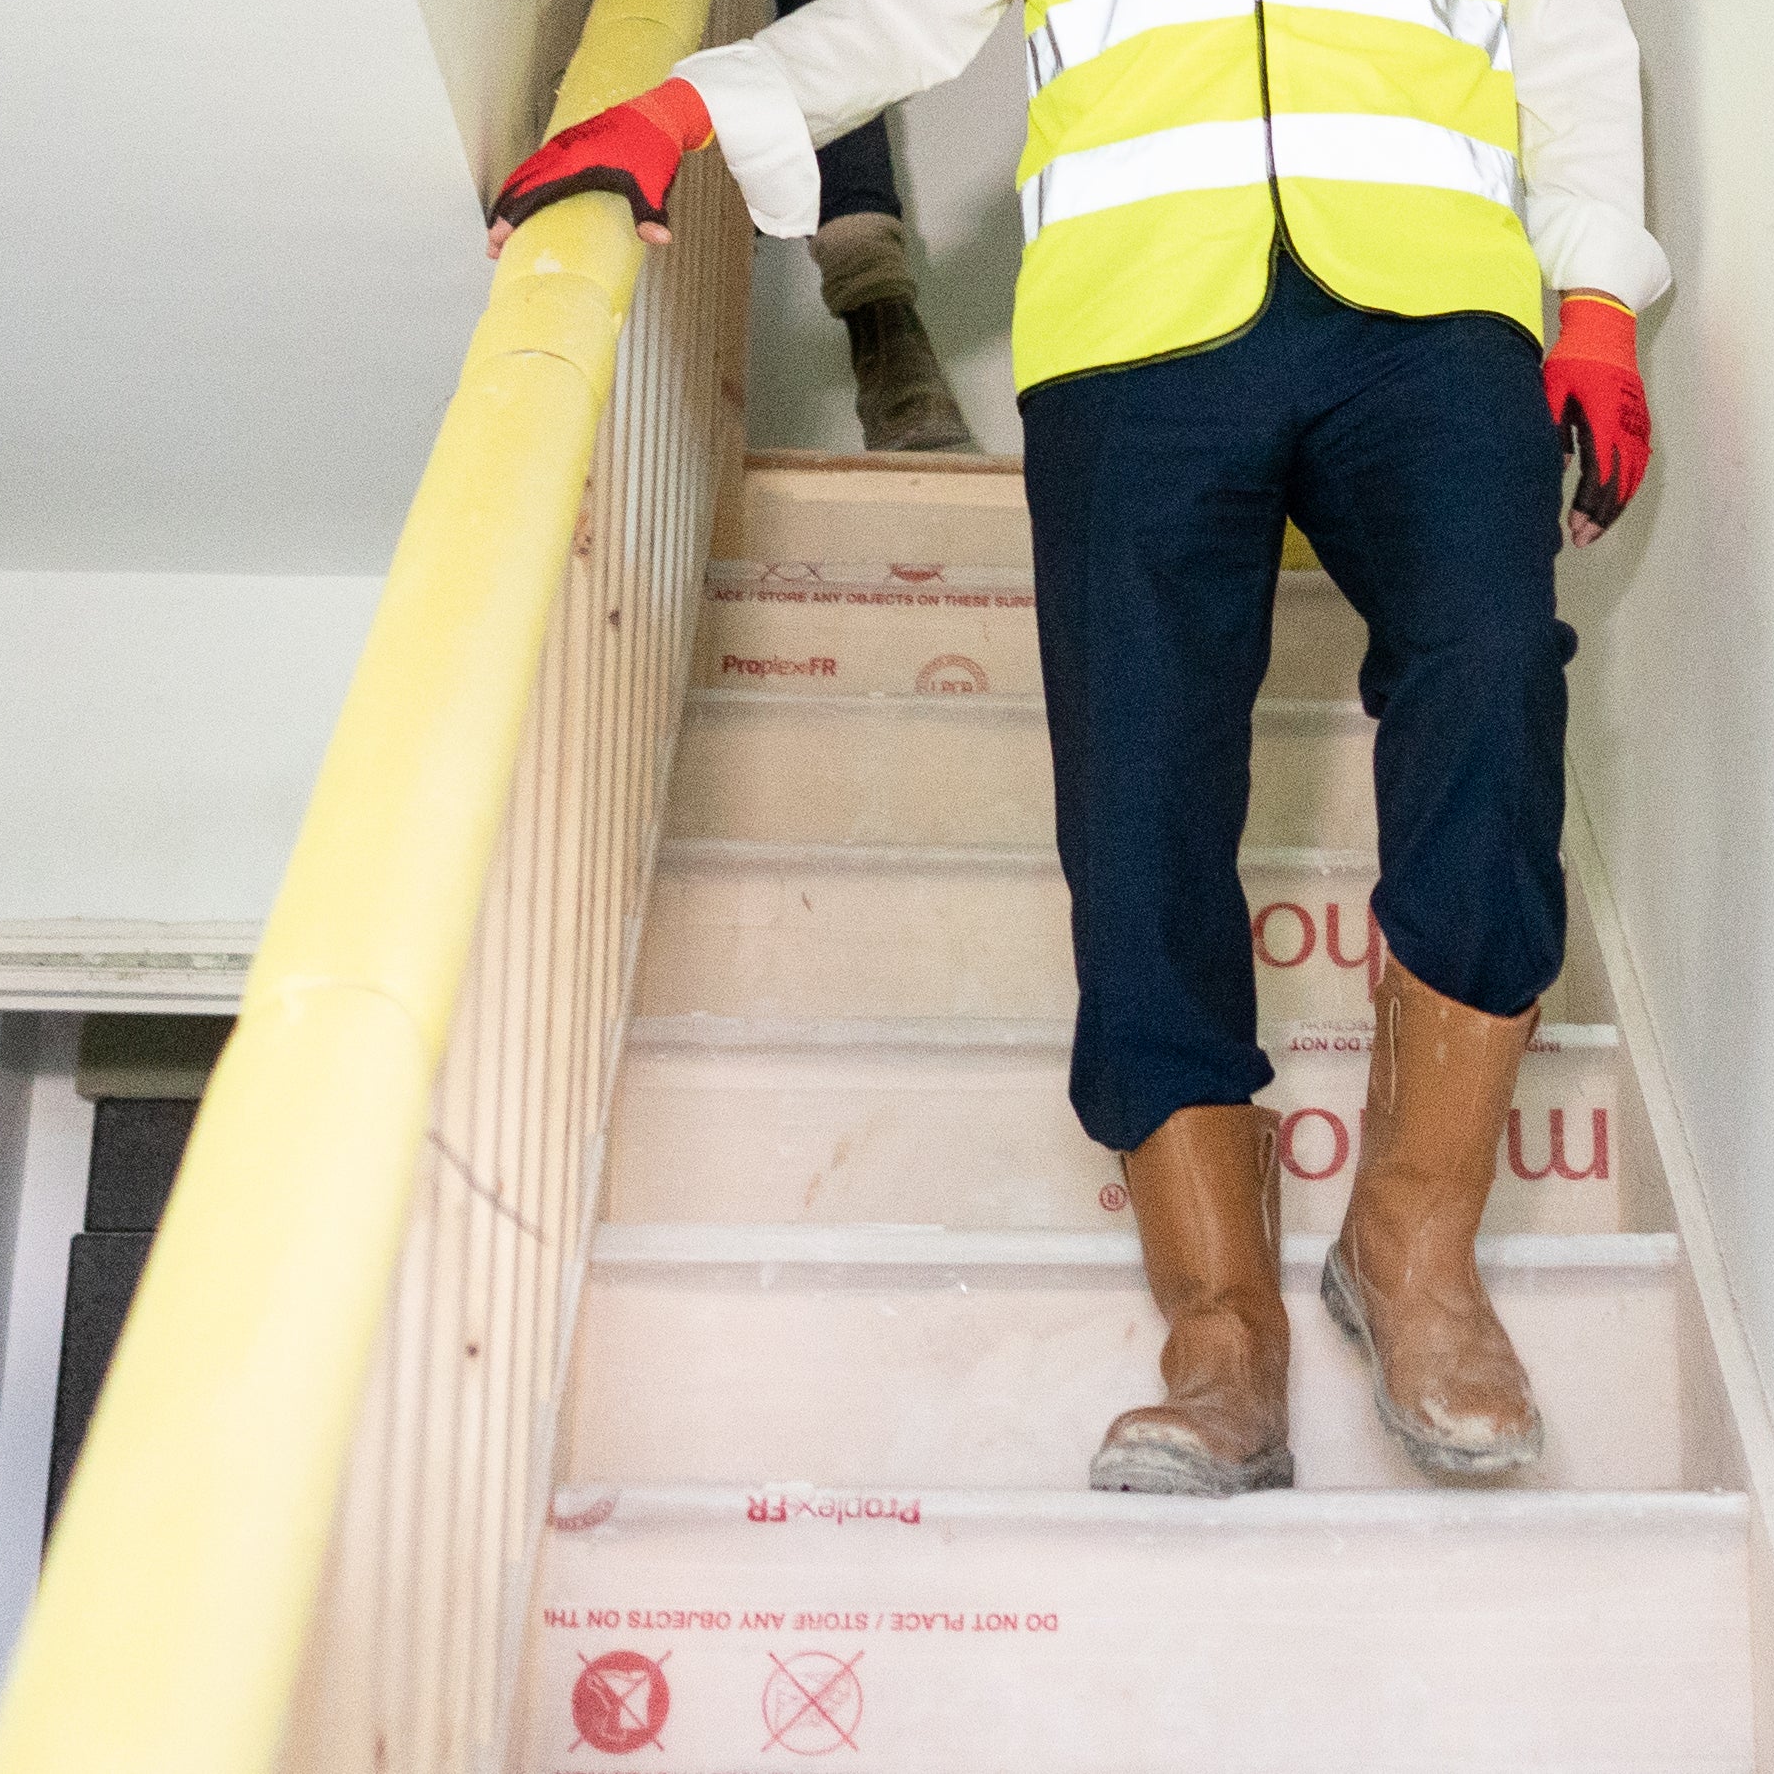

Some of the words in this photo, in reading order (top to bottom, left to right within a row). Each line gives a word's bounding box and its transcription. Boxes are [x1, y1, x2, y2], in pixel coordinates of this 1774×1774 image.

[756, 589, 806, 603] STORE
[811, 591, 842, 604] ANY
[846, 592, 914, 605] OBJECTS
[917, 594, 940, 607] ON
[944, 594, 990, 608] THESE
[994, 595, 1035, 608] SURF
[1289, 1037, 1328, 1052] NOT
[1333, 1037, 1361, 1052] DO
[586, 1609, 621, 1629] ON
[627, 1609, 733, 1630] OBJECTS
[740, 1611, 786, 1631] ANY
[793, 1611, 870, 1631] STORE
[890, 1612, 965, 1632] PLACE
[971, 1612, 1019, 1632] NOT
[1025, 1612, 1059, 1632] DO
